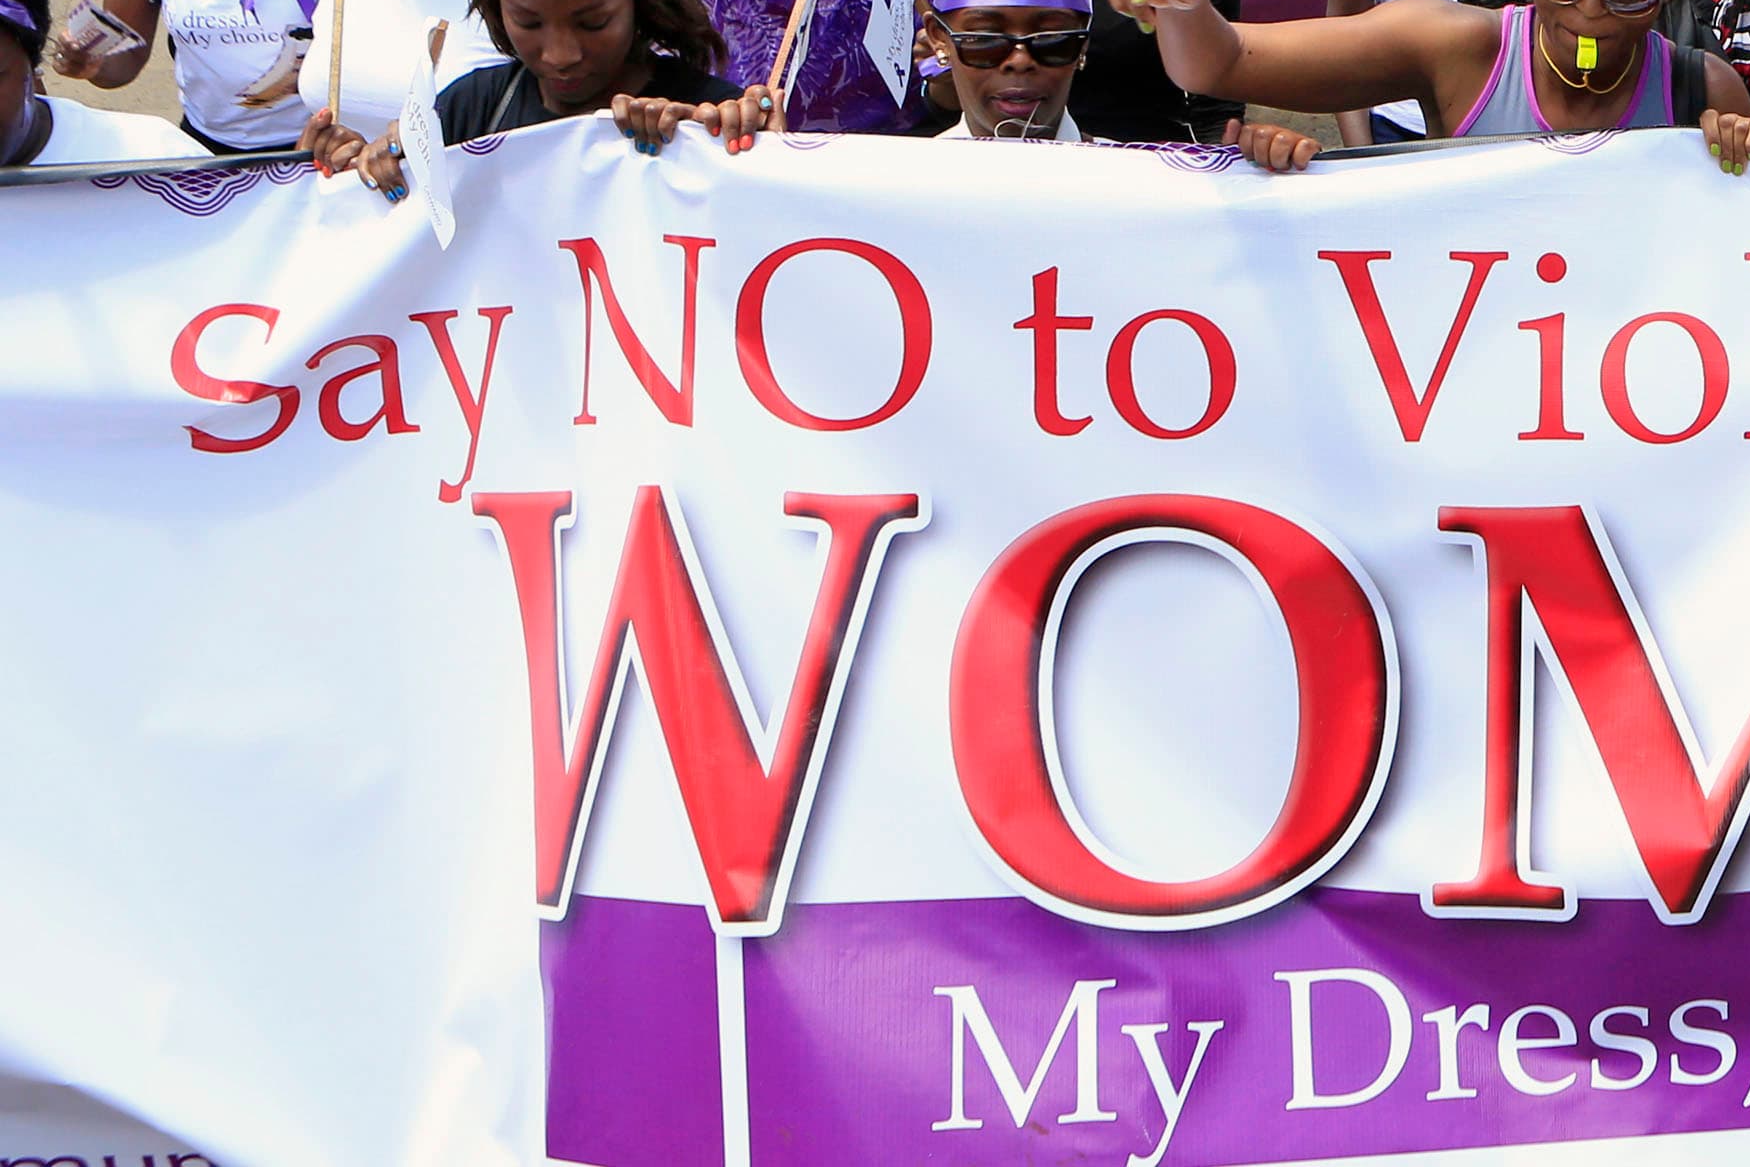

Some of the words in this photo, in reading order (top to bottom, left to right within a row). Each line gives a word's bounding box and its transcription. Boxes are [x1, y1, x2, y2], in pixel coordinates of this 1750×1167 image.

[175, 28, 212, 50] My
[170, 303, 513, 504] Say
[558, 233, 933, 432] NO
[1013, 265, 1238, 442] to
[931, 978, 1226, 1167] My
